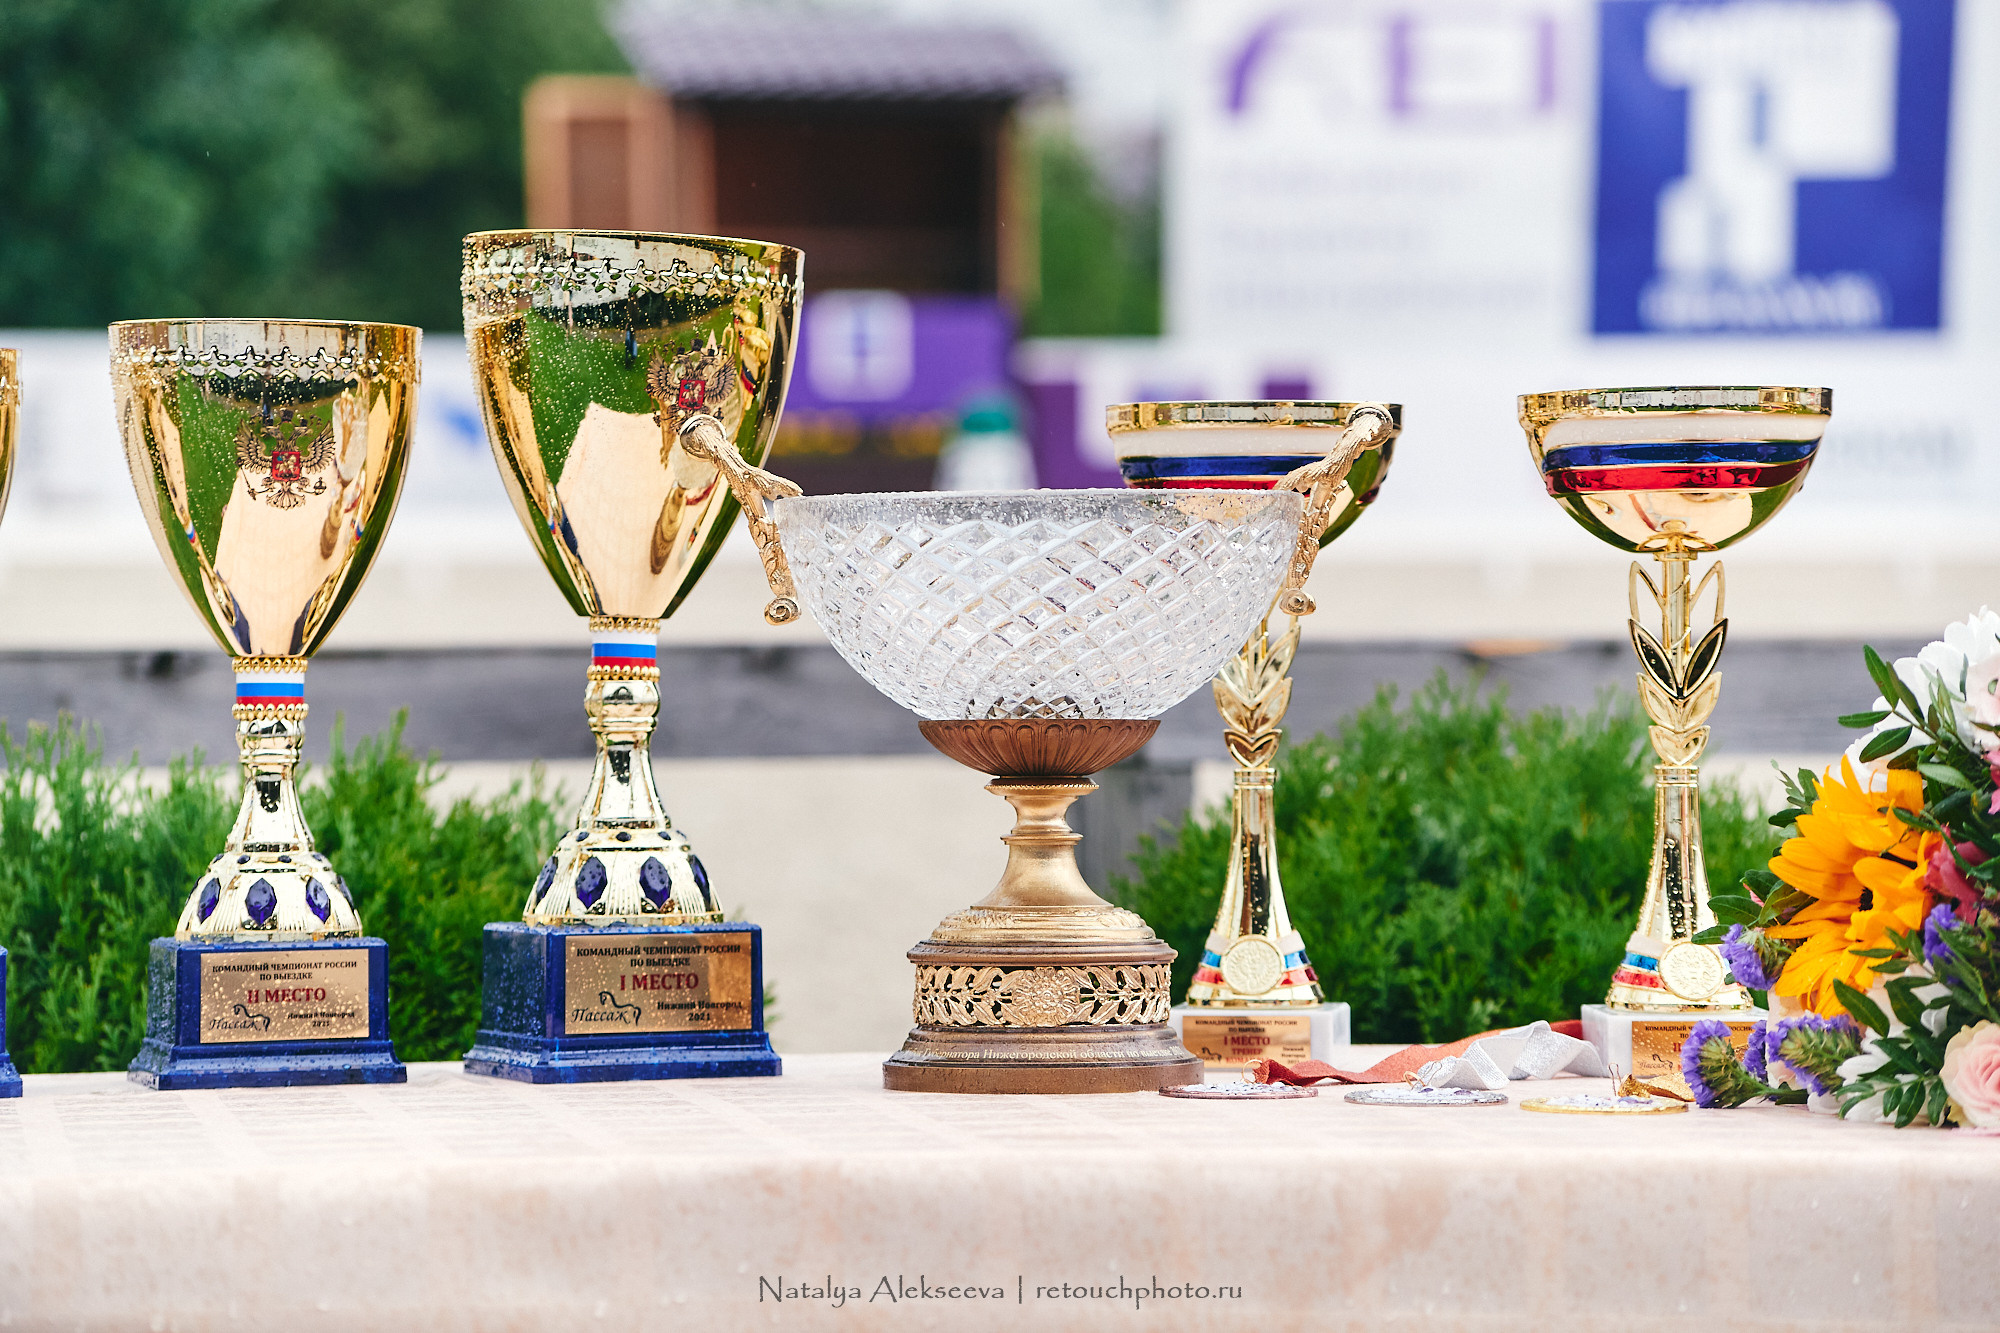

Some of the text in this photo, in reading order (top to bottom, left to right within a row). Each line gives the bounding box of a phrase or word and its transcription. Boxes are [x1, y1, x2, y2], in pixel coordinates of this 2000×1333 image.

[576, 944, 741, 957] КОМАНДНЫЙ ЧЕМПИОНАТ РОССИИ
[212, 961, 357, 973] КОМАНДНЫЙ ЧЕМПИОНАТ РОССИИ
[631, 957, 690, 968] ПО ВЫЕЗДКЕ
[259, 972, 313, 981] ПО ВЫЕЗДКЕ
[632, 973, 699, 990] МЕСТО
[265, 988, 326, 1003] МЕСТО
[657, 1001, 743, 1010] Нижний Новгород
[571, 1008, 631, 1024] Пассаж
[688, 1013, 711, 1022] 2021
[1231, 1036, 1271, 1046] МЕСТО
[983, 1049, 1077, 1060] Нижегородской
[1080, 1048, 1125, 1059] области
